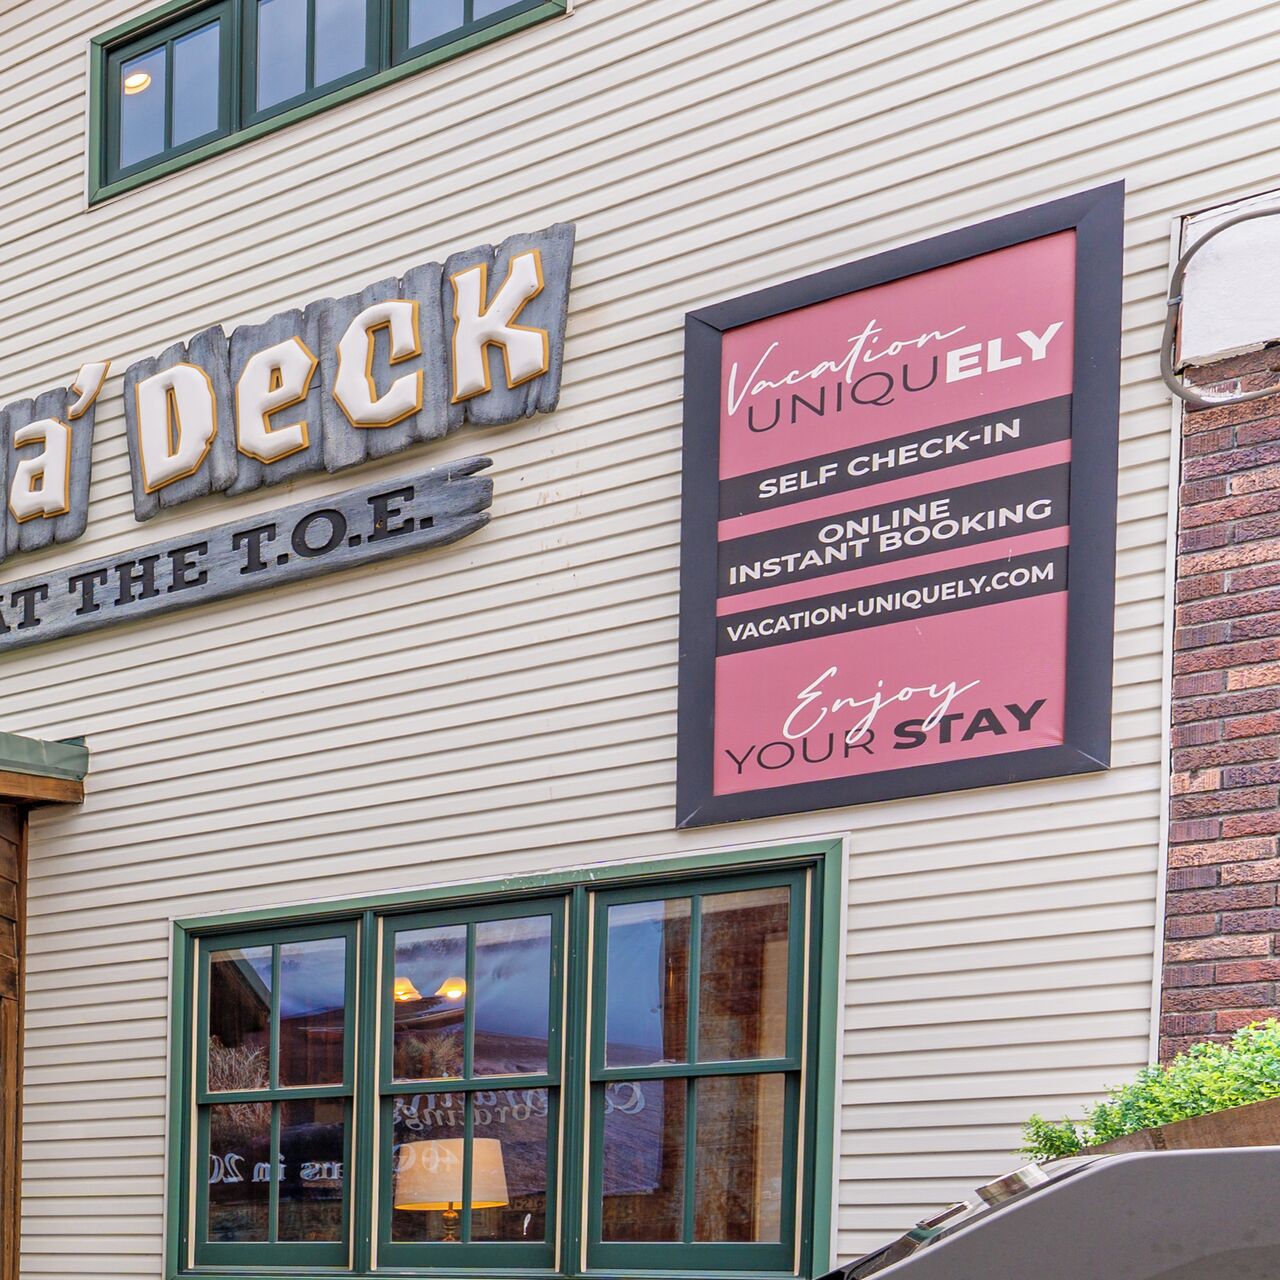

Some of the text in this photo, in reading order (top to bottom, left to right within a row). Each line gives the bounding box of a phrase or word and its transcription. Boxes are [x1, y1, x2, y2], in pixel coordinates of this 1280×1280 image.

[727, 319, 967, 416] Vacation
[747, 321, 1064, 433] UNIQUELY
[758, 418, 1021, 499] SELF CHECK-IN
[68, 542, 208, 616] THE
[231, 485, 435, 576] T.O.E.
[729, 498, 1052, 585] INSTANT BOOKING
[818, 498, 951, 544] ONLINE
[727, 562, 1054, 642] VACATION-UNIQUELY.COM
[725, 698, 1048, 775] YOUR STAY
[783, 666, 981, 744] Enjoy
